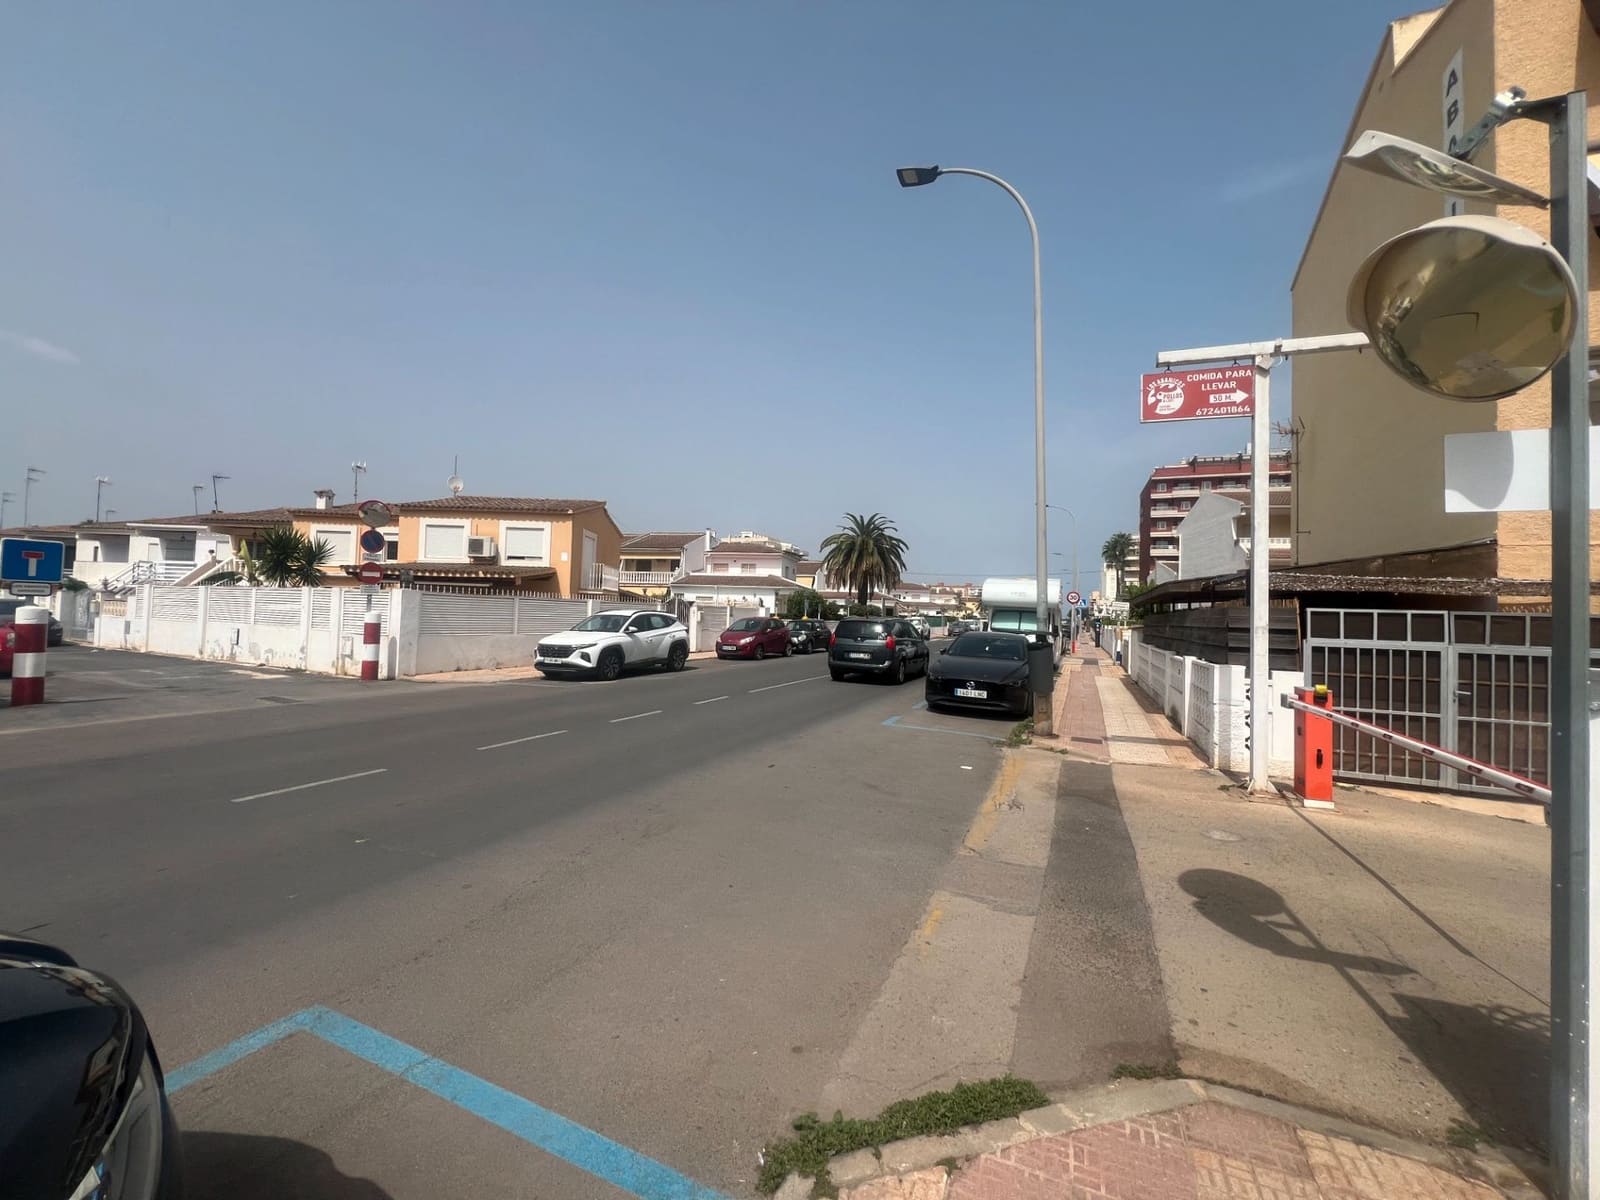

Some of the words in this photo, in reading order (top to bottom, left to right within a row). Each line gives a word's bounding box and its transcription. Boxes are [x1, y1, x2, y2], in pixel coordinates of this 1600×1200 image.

[1187, 372, 1223, 382] COMIDA
[1226, 369, 1252, 378] PARA
[1201, 381, 1237, 391] LLEVAR
[1196, 405, 1250, 416] 672401864
